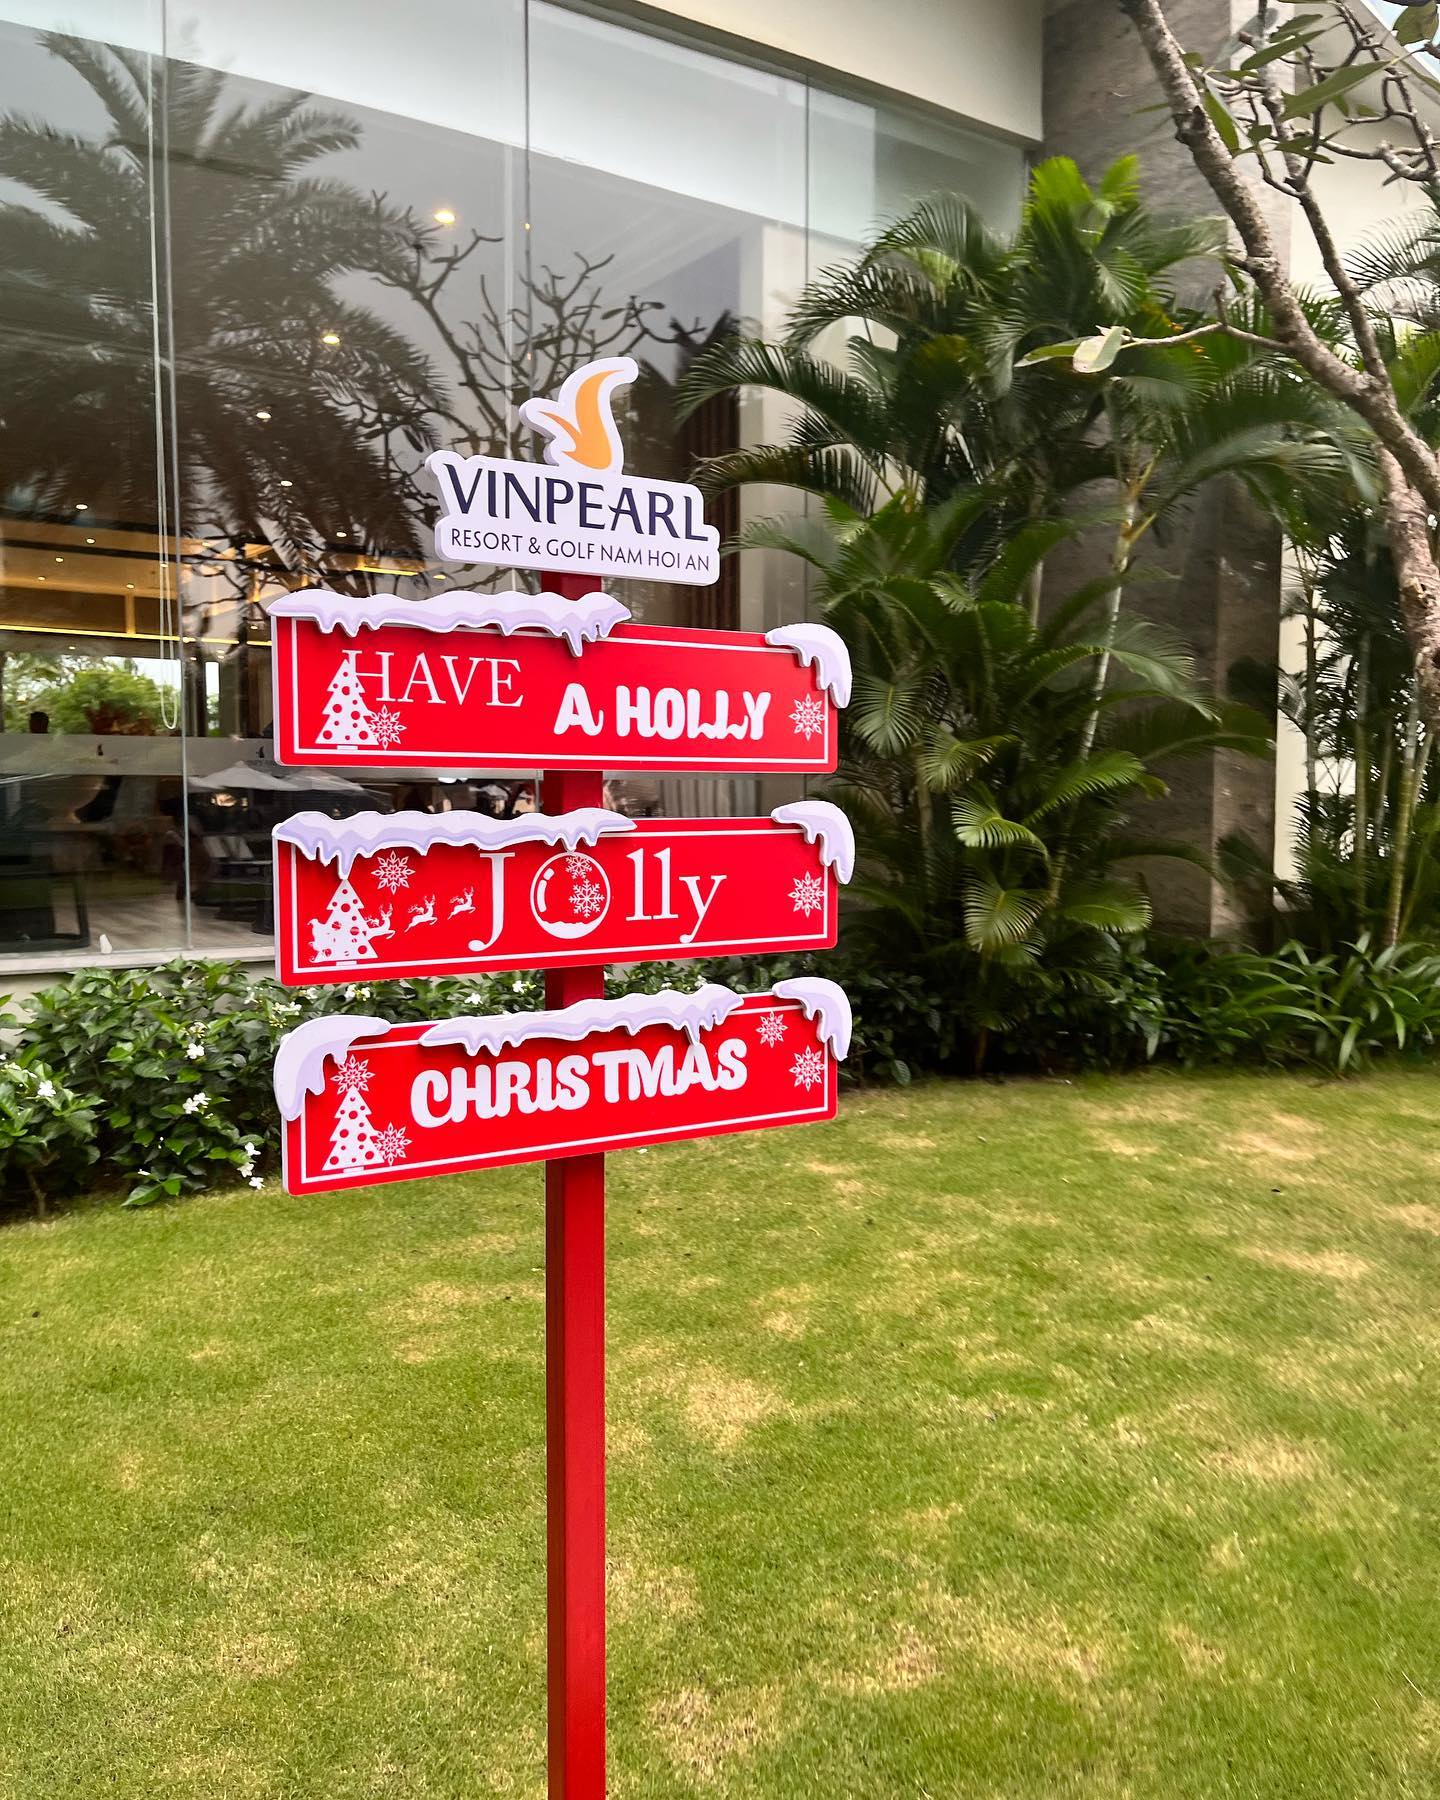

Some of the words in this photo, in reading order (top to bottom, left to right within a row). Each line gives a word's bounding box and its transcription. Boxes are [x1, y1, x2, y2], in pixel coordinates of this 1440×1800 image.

[444, 463, 709, 541] VINPEARL
[451, 528, 523, 552] RESORT
[528, 537, 541, 555] &
[546, 539, 595, 560] GOLF
[601, 544, 642, 565] NAM
[648, 550, 680, 568] HOI
[685, 555, 709, 571] AN
[342, 649, 524, 706] HAVE
[553, 683, 602, 737] A
[616, 685, 771, 740] HOLLY
[411, 1038, 748, 1128] CHRISTMAS
